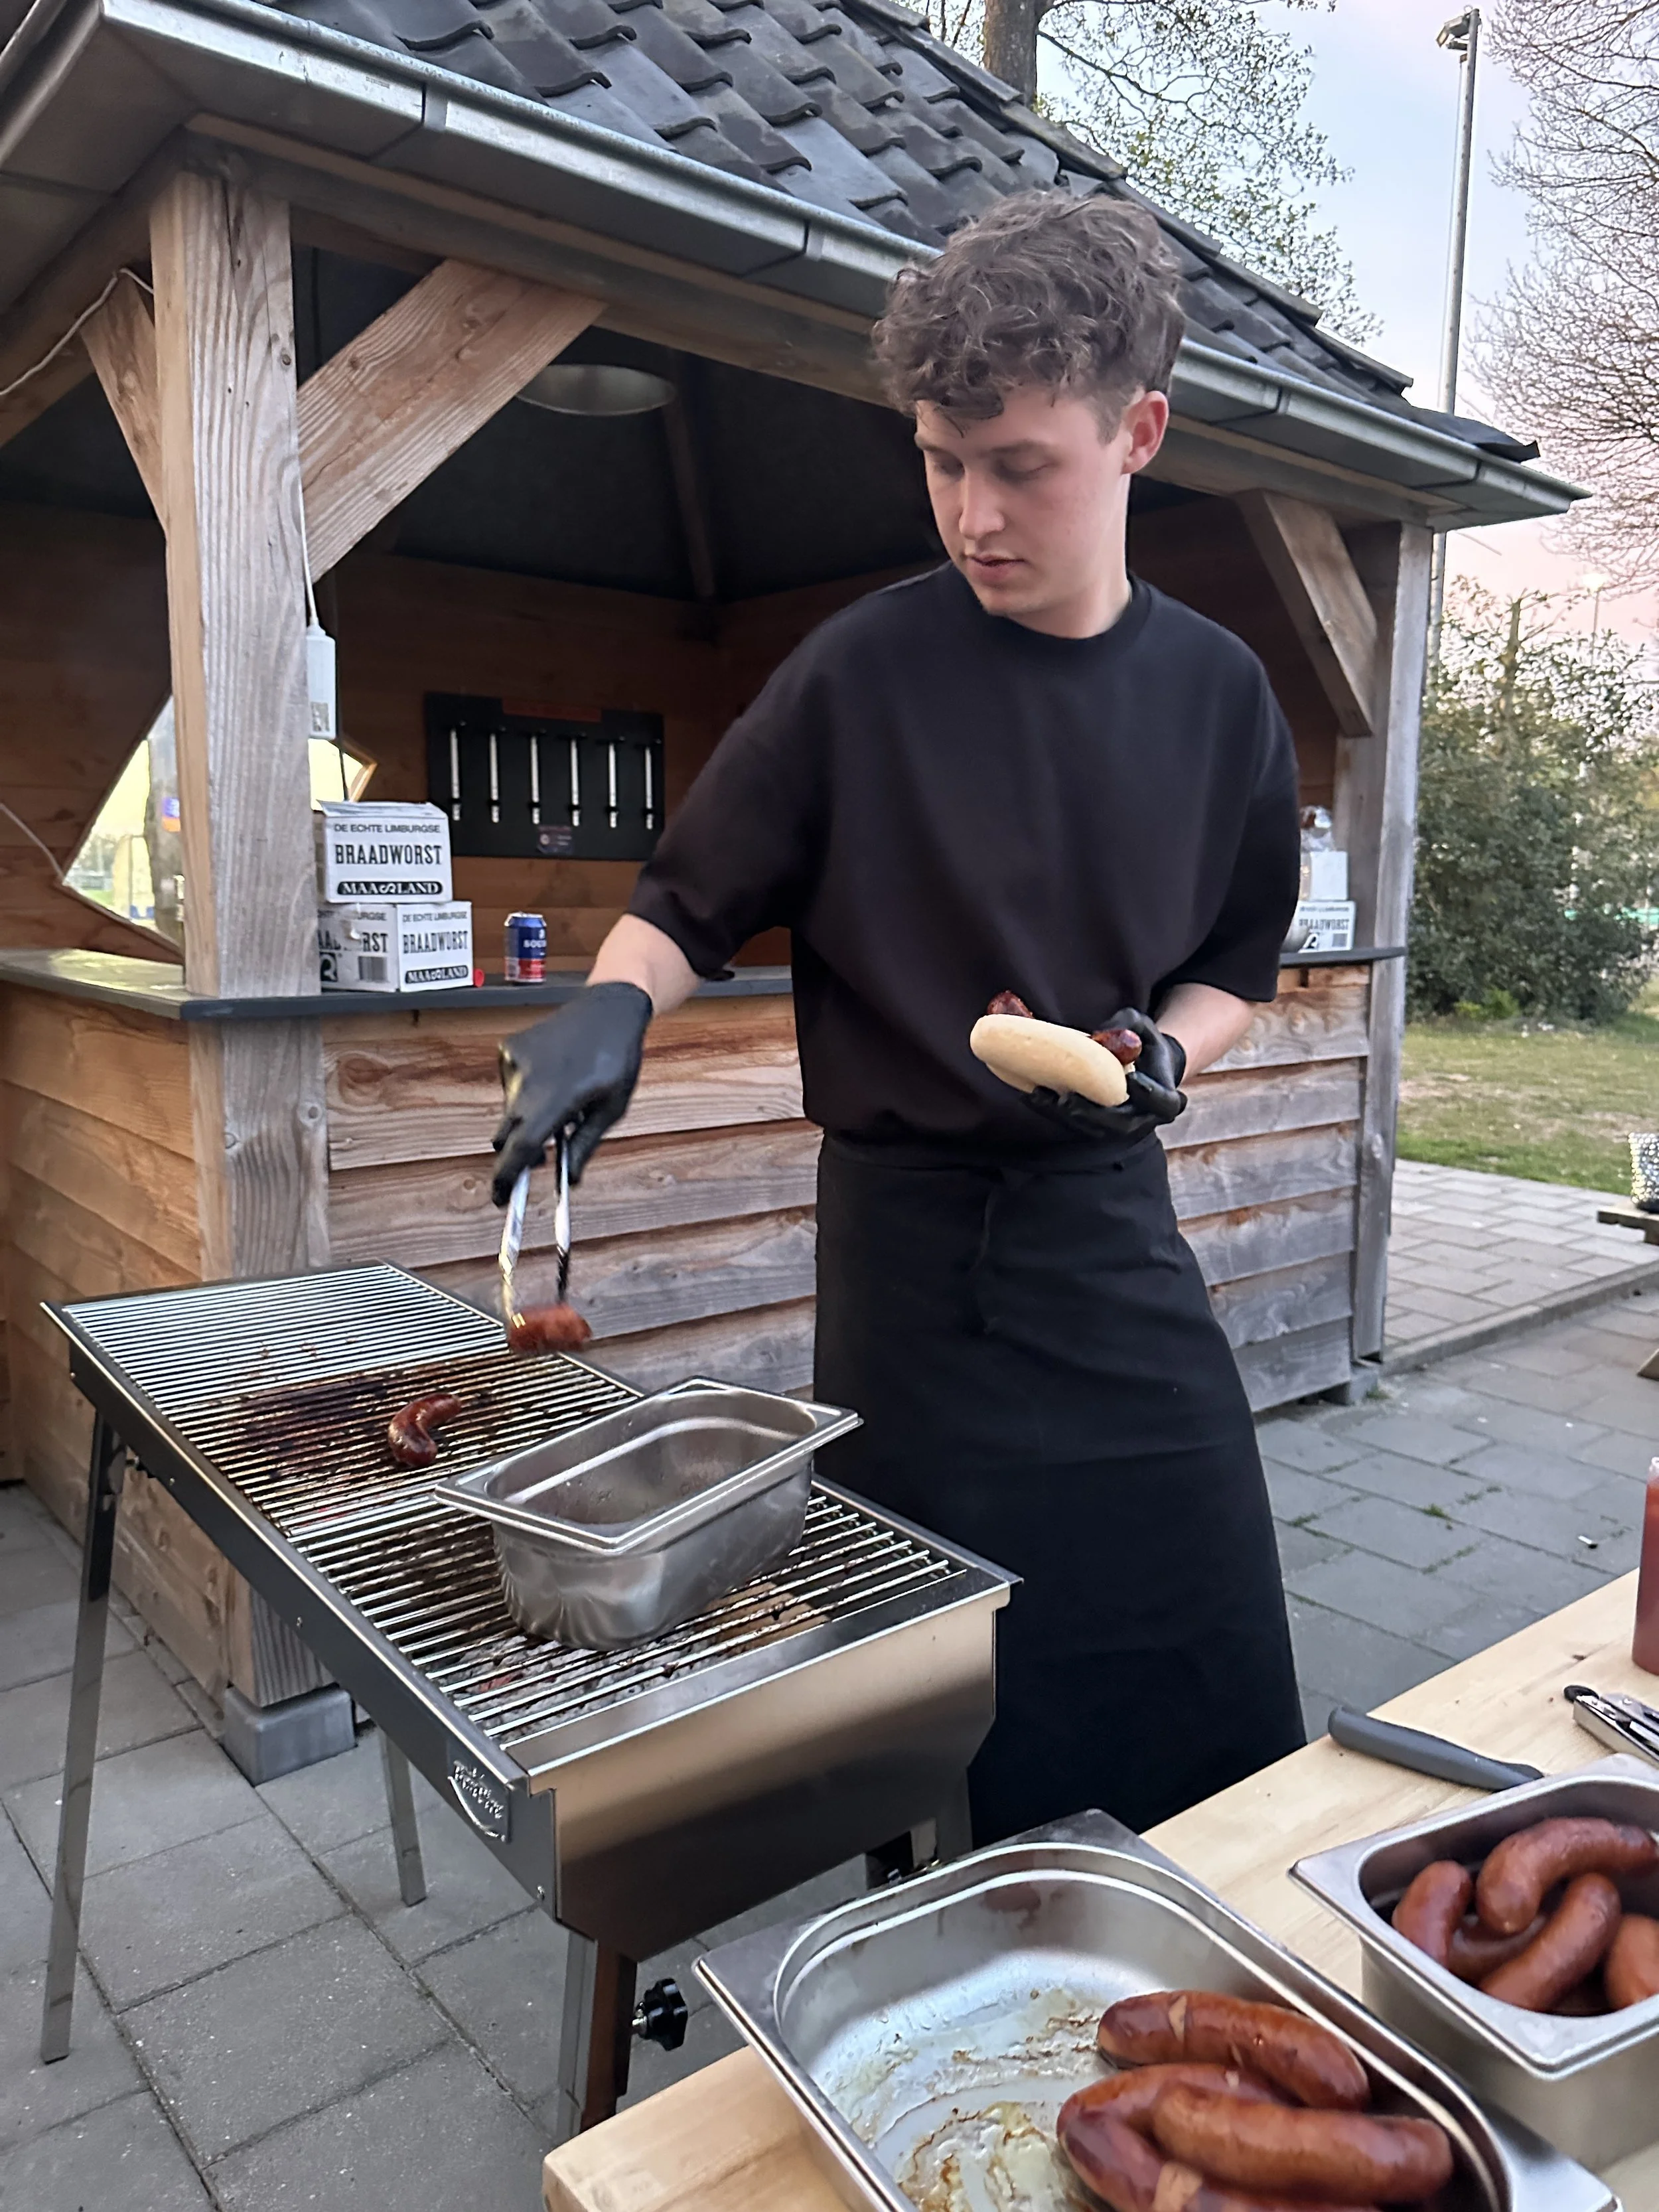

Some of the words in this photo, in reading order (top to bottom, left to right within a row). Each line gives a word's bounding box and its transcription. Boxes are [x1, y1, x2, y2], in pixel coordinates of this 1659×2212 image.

[334, 824, 348, 832] DE
[350, 824, 382, 833] ECHTE
[385, 824, 441, 834] LIMBURGSE
[334, 844, 442, 865] BRAADWORST
[402, 930, 468, 954] BRAADWORST
